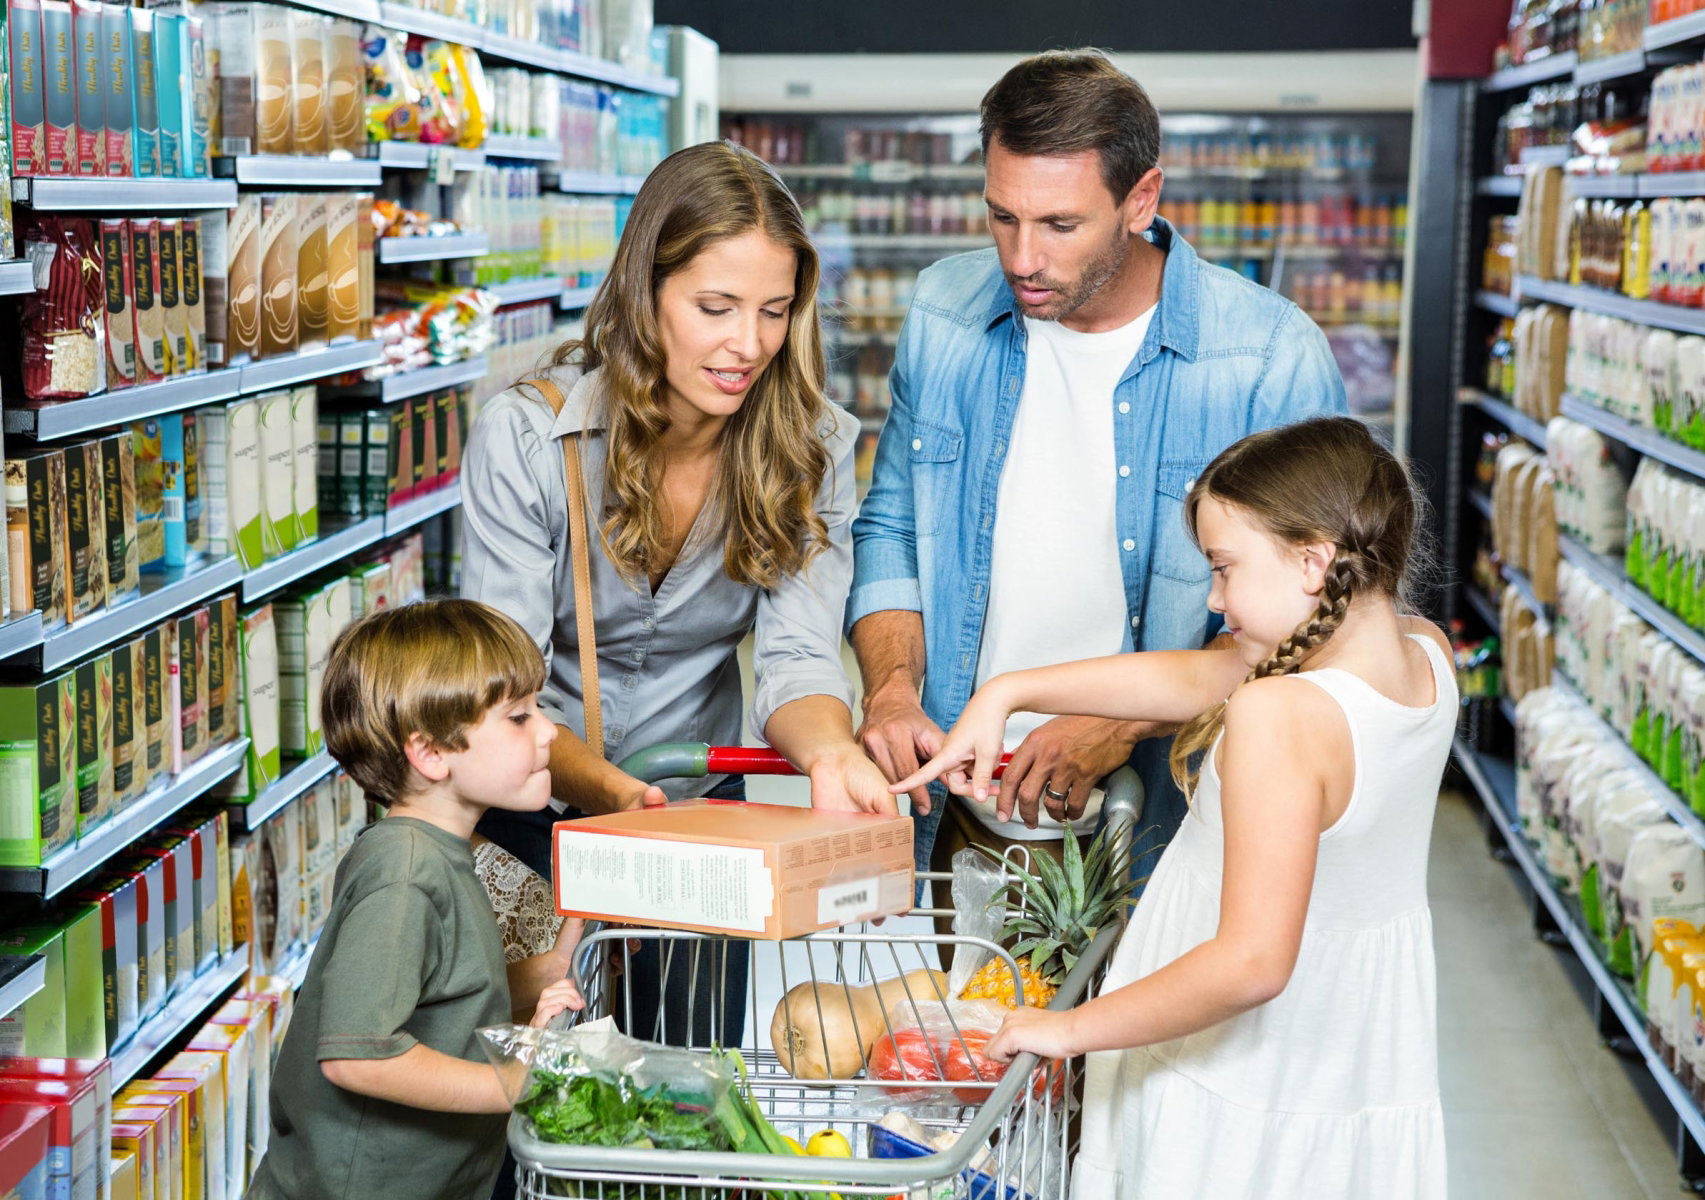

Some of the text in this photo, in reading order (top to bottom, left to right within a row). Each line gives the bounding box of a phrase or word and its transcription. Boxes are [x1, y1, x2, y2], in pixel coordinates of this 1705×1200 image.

[107, 239, 121, 303] Healthy Oats
[136, 238, 150, 302] Healthy Oats
[161, 238, 175, 302] Healthy Oats
[184, 236, 197, 301] Healthy Oats
[32, 479, 47, 544] Healthy Oats
[70, 467, 85, 532] Healthy Oats
[106, 458, 120, 522] Healthy Oats
[182, 638, 195, 700] Healthy Oats
[210, 622, 223, 684] Healthy Oats
[116, 671, 130, 736] Healthy Oats
[147, 655, 160, 718] Healthy Oats
[43, 702, 57, 767] Healthy Oats
[80, 688, 94, 753] Healthy Oats
